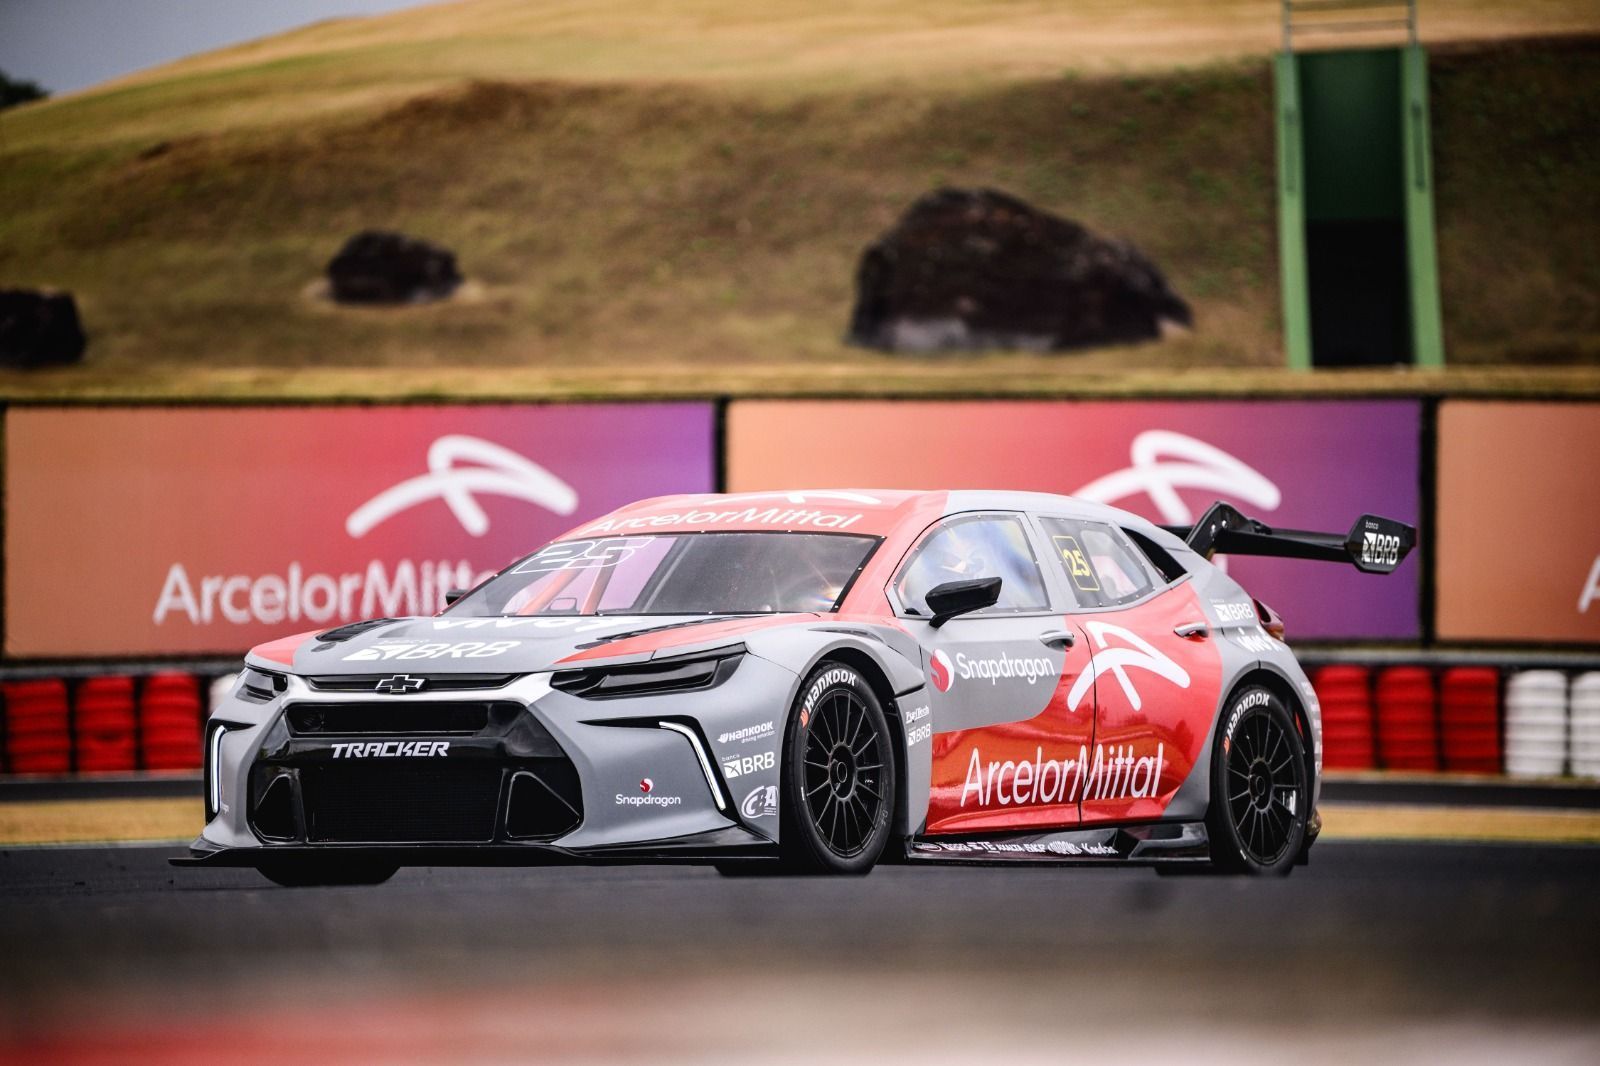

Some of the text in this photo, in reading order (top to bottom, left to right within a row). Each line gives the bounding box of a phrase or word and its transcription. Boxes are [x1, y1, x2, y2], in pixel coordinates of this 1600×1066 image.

[582, 508, 862, 534] ArcelorMittal
[511, 537, 656, 575] 25
[1374, 533, 1400, 565] BRB
[1064, 549, 1091, 577] 25
[153, 559, 502, 625] ArcelorMitt
[1230, 603, 1253, 620] BRB
[395, 640, 522, 660] BRB
[955, 653, 1055, 685] Snapdragon
[915, 723, 931, 742] BRB
[330, 741, 450, 759] TRACKER
[743, 751, 775, 775] BRB
[960, 742, 1164, 807] ArcelorMittal
[615, 794, 681, 807] Snapdragon
